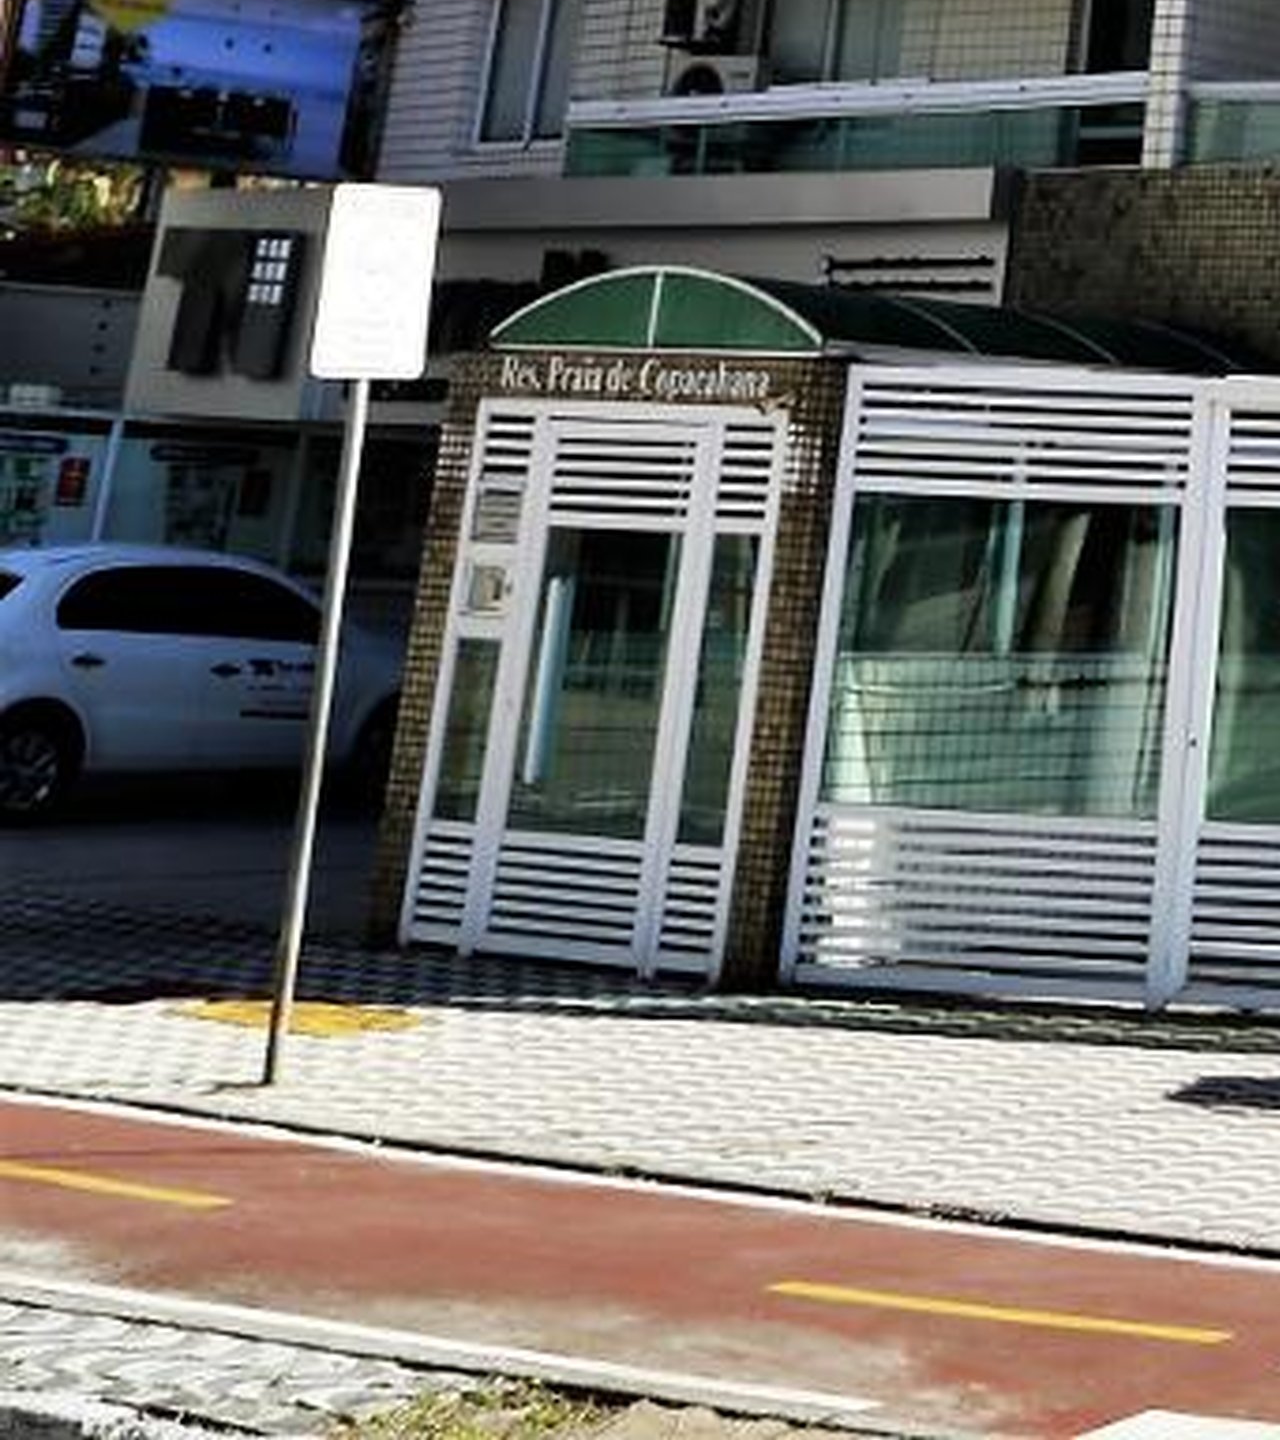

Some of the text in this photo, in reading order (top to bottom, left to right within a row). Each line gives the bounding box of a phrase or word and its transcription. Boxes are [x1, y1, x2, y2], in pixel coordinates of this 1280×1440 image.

[500, 356, 771, 400] Res. Praia de Copacabana
